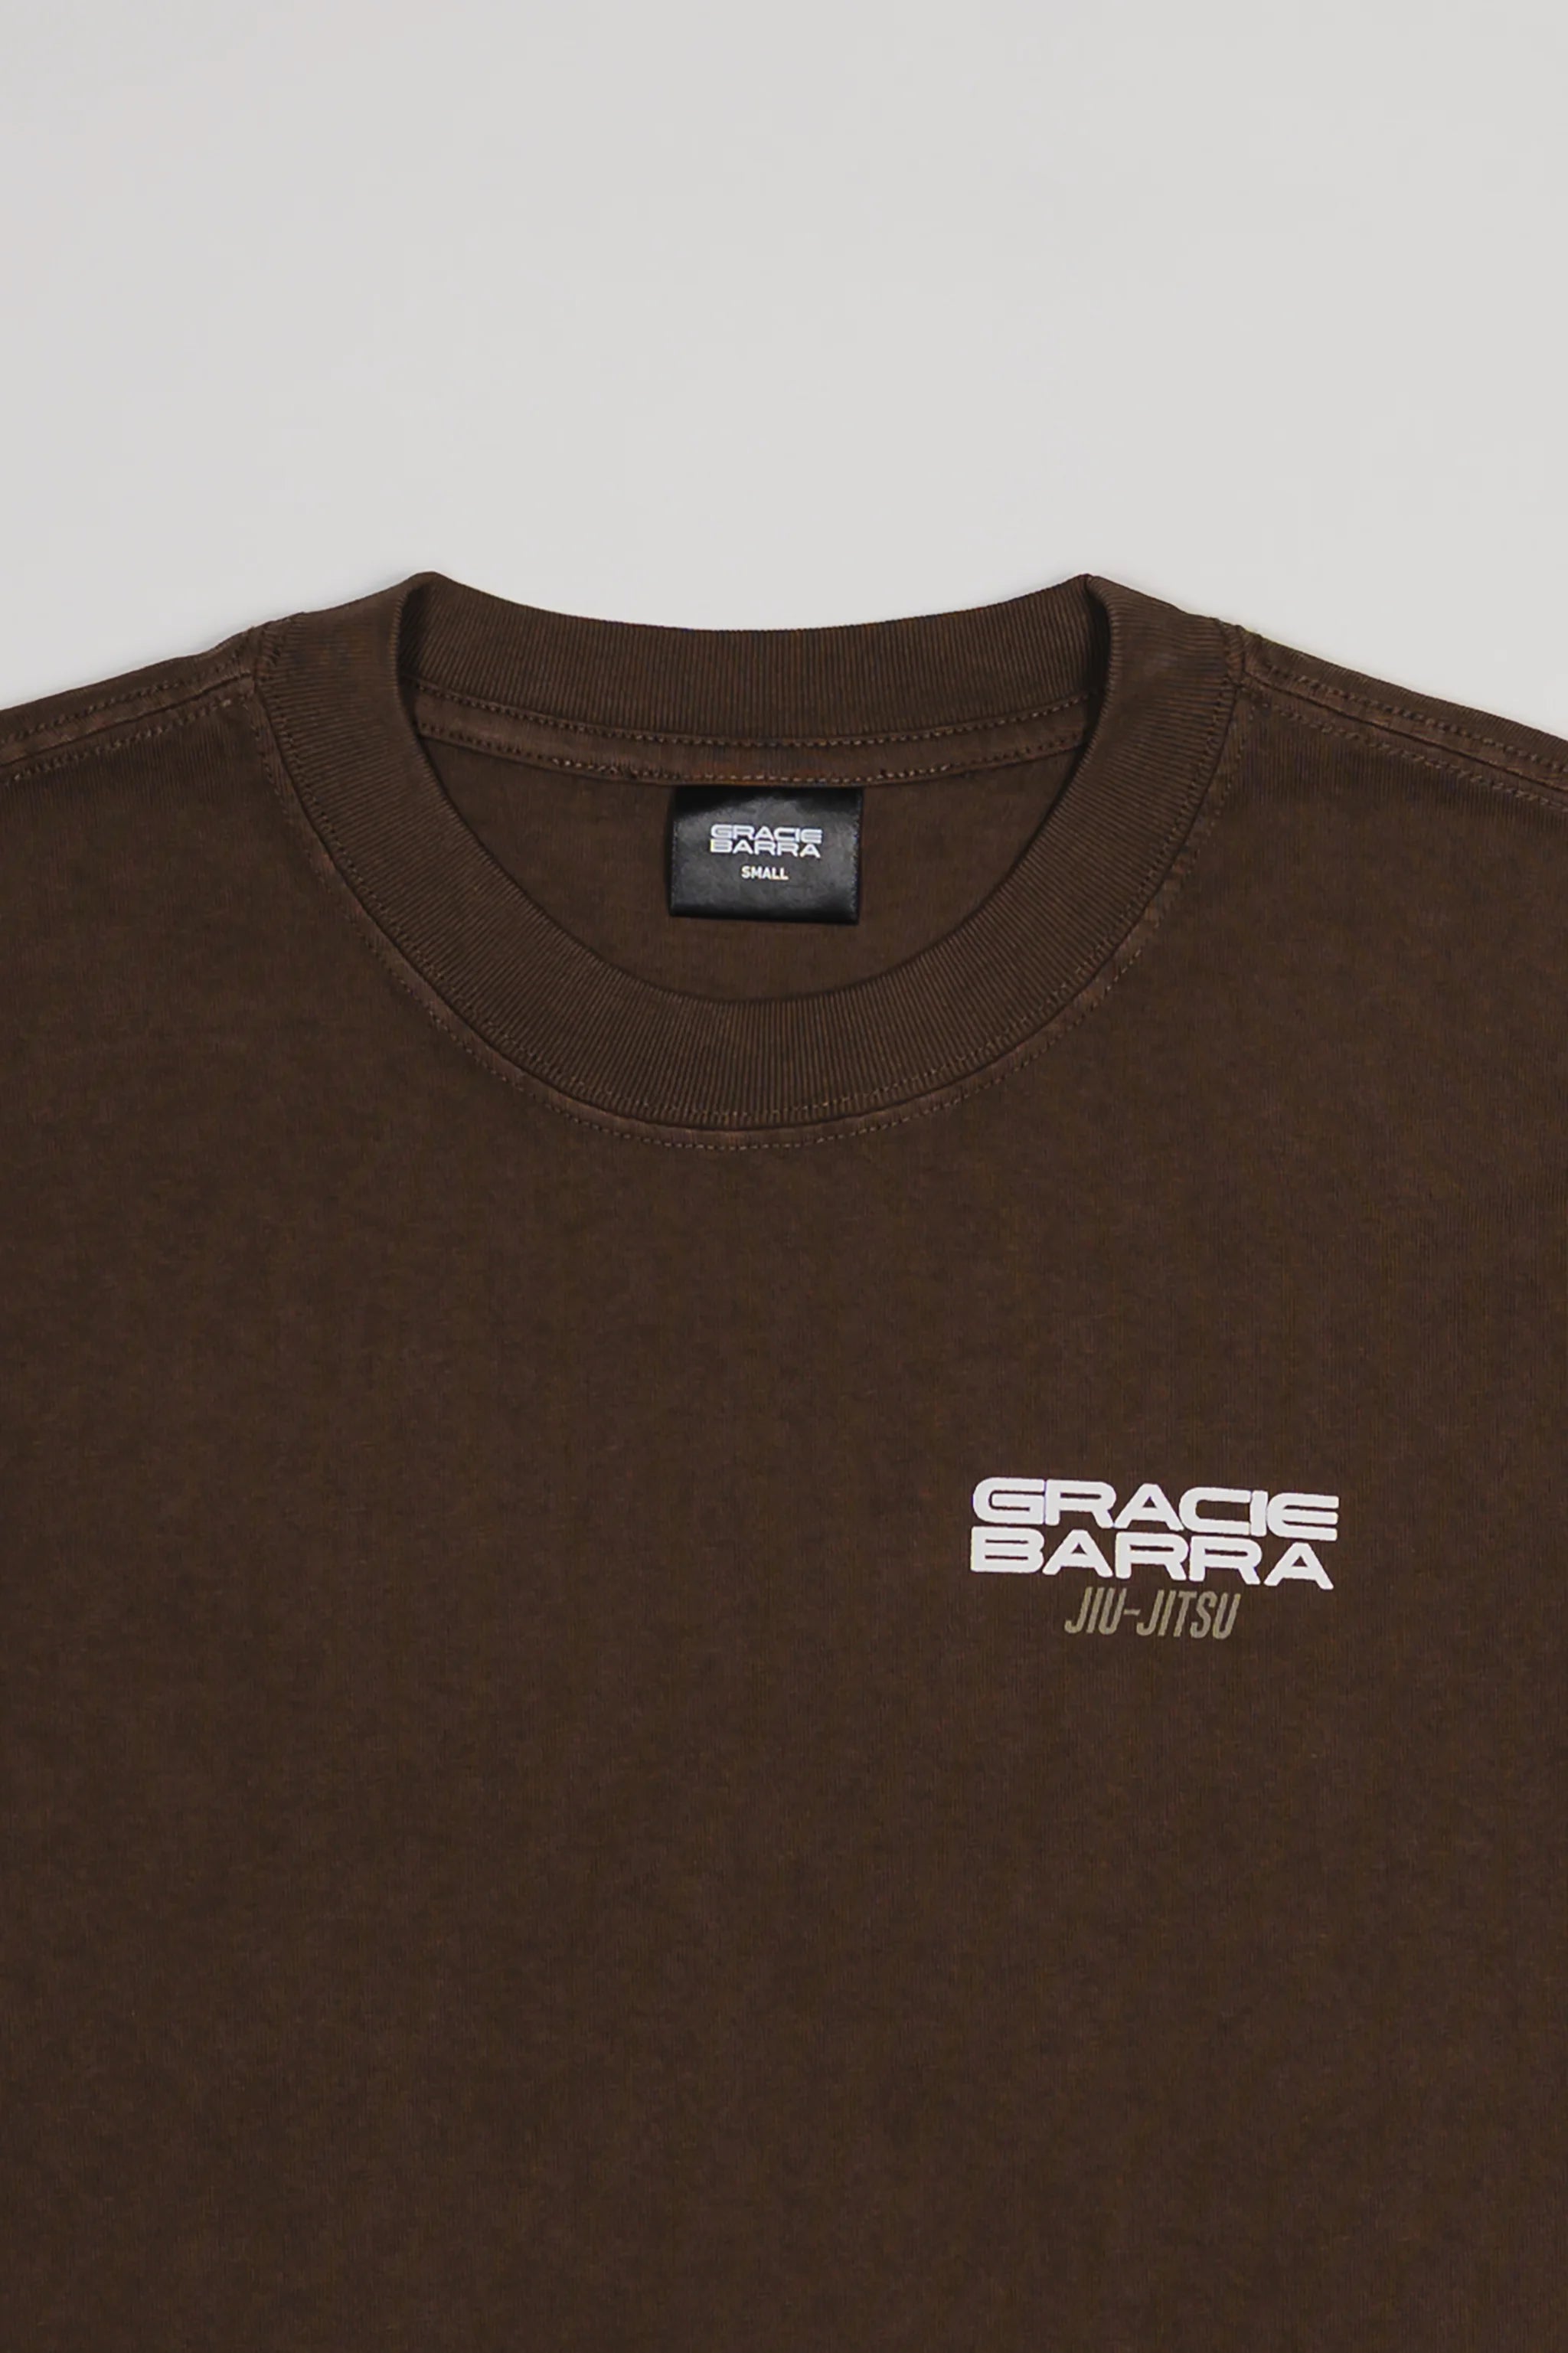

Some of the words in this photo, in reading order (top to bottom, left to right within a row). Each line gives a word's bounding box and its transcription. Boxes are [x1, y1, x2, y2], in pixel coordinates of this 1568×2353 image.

[710, 824, 823, 844] GRACIE
[710, 838, 822, 858] BARRA
[741, 865, 789, 881] SMALL
[973, 1477, 1339, 1541] GRACIE
[970, 1526, 1334, 1590] BARRA
[1064, 1587, 1241, 1639] JIU-JITSU
